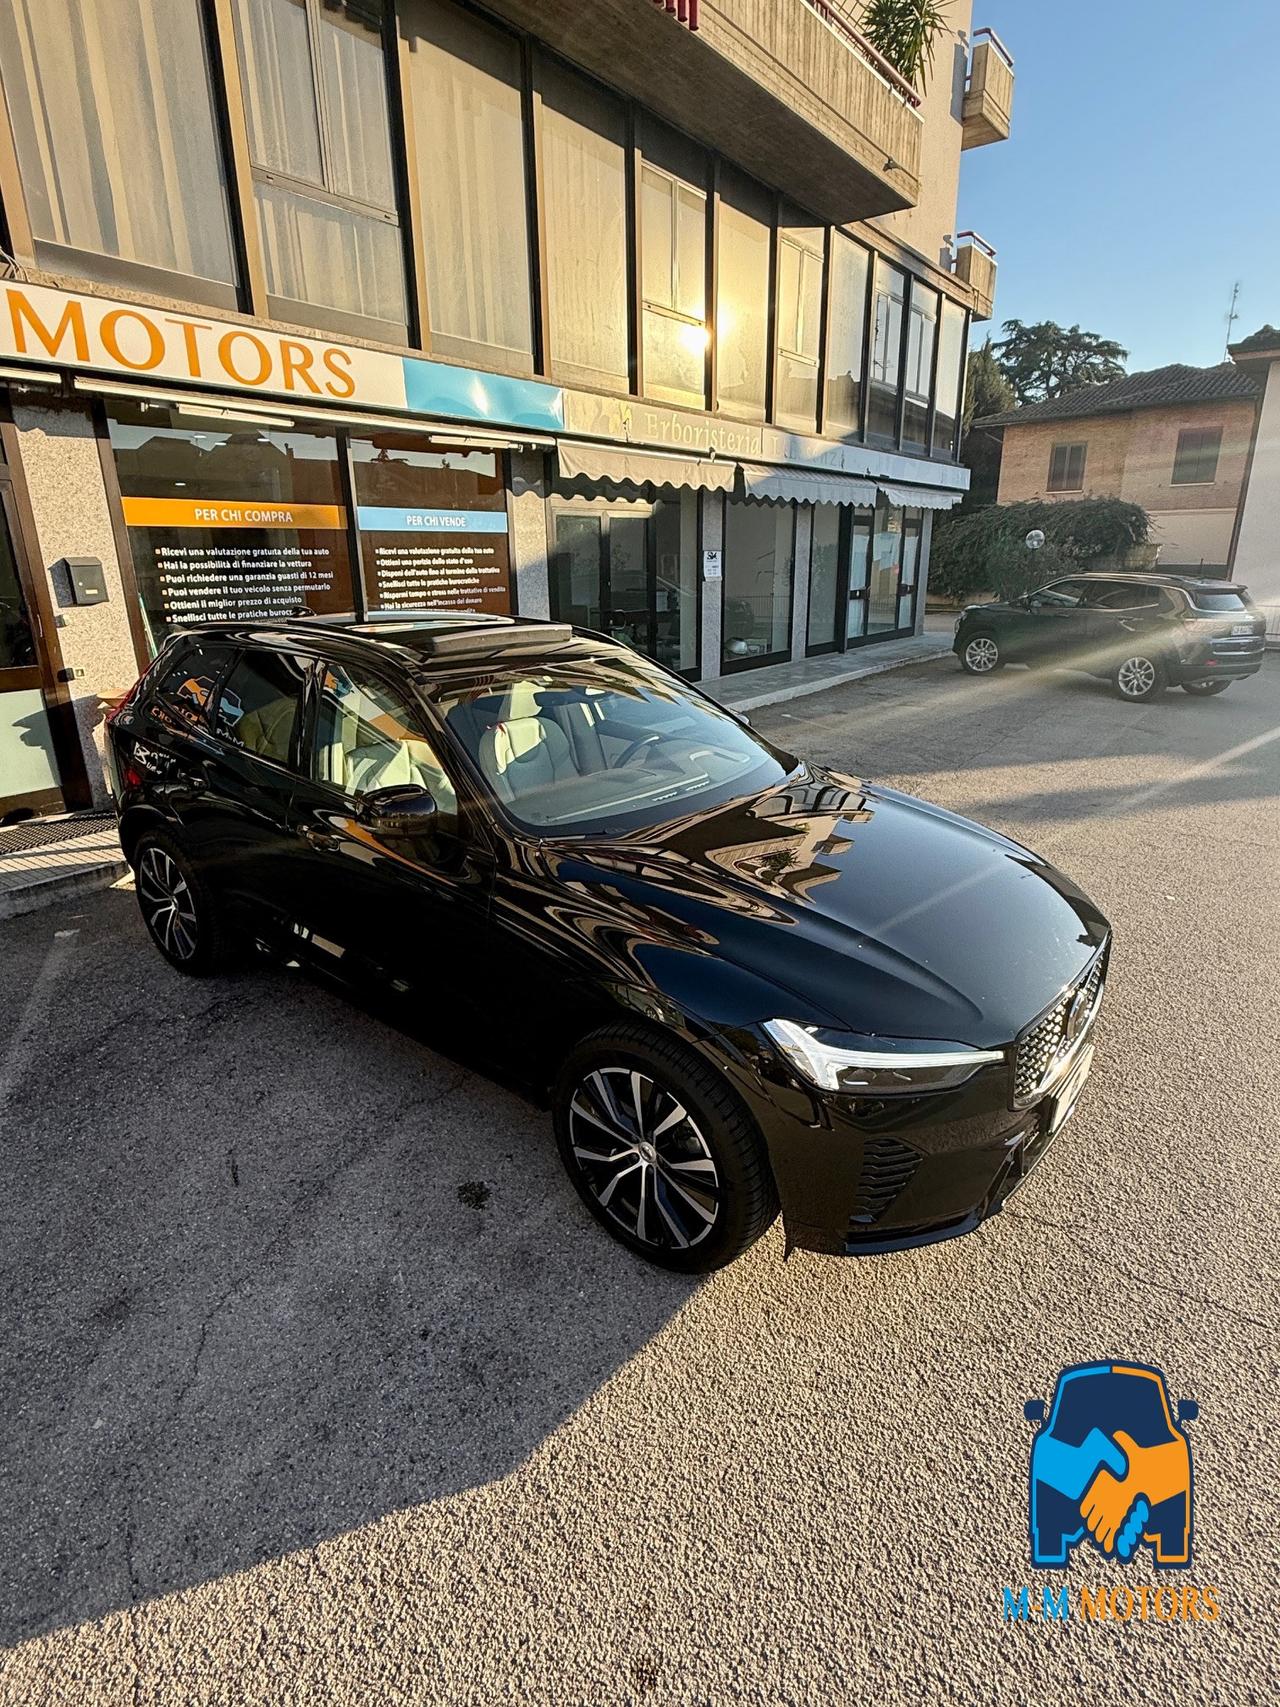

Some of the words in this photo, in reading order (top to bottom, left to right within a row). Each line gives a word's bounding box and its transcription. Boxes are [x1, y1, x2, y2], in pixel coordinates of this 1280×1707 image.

[6, 288, 356, 398] MOTORS
[644, 412, 761, 455] Erboristeria
[194, 508, 218, 521] PER
[221, 509, 242, 521] CHI
[244, 510, 293, 523] COMPRA
[406, 515, 423, 526] PER
[424, 515, 438, 526] CHI
[440, 516, 466, 527] VENDE
[161, 547, 187, 557] Ricevi
[206, 547, 250, 556] valutazione
[252, 548, 282, 557] gratuita
[283, 548, 300, 556] della
[163, 561, 178, 570] Hai
[180, 560, 188, 570] la
[232, 560, 240, 568] di
[241, 560, 278, 568] finanziare
[278, 560, 286, 568] la
[286, 560, 312, 568] vettura
[165, 574, 185, 583] Puoi
[186, 574, 227, 582] richiedere
[245, 573, 276, 582] garanzia
[277, 572, 299, 581] guasti
[300, 571, 307, 579] di
[318, 571, 334, 579] mesi
[167, 588, 187, 596] Puoi
[188, 587, 221, 595] vendere
[222, 586, 228, 594] il
[244, 584, 271, 593] veicolo
[293, 583, 330, 592] permutarlo
[170, 600, 200, 609] Ottieni
[201, 600, 207, 608] il
[208, 599, 236, 609] miglior
[238, 599, 262, 607] prezzo
[264, 597, 270, 605] di
[272, 596, 302, 605] acquisto
[172, 613, 206, 623] Snellisci
[207, 612, 227, 620] tutte
[228, 611, 236, 619] le
[237, 610, 268, 619] pratiche
